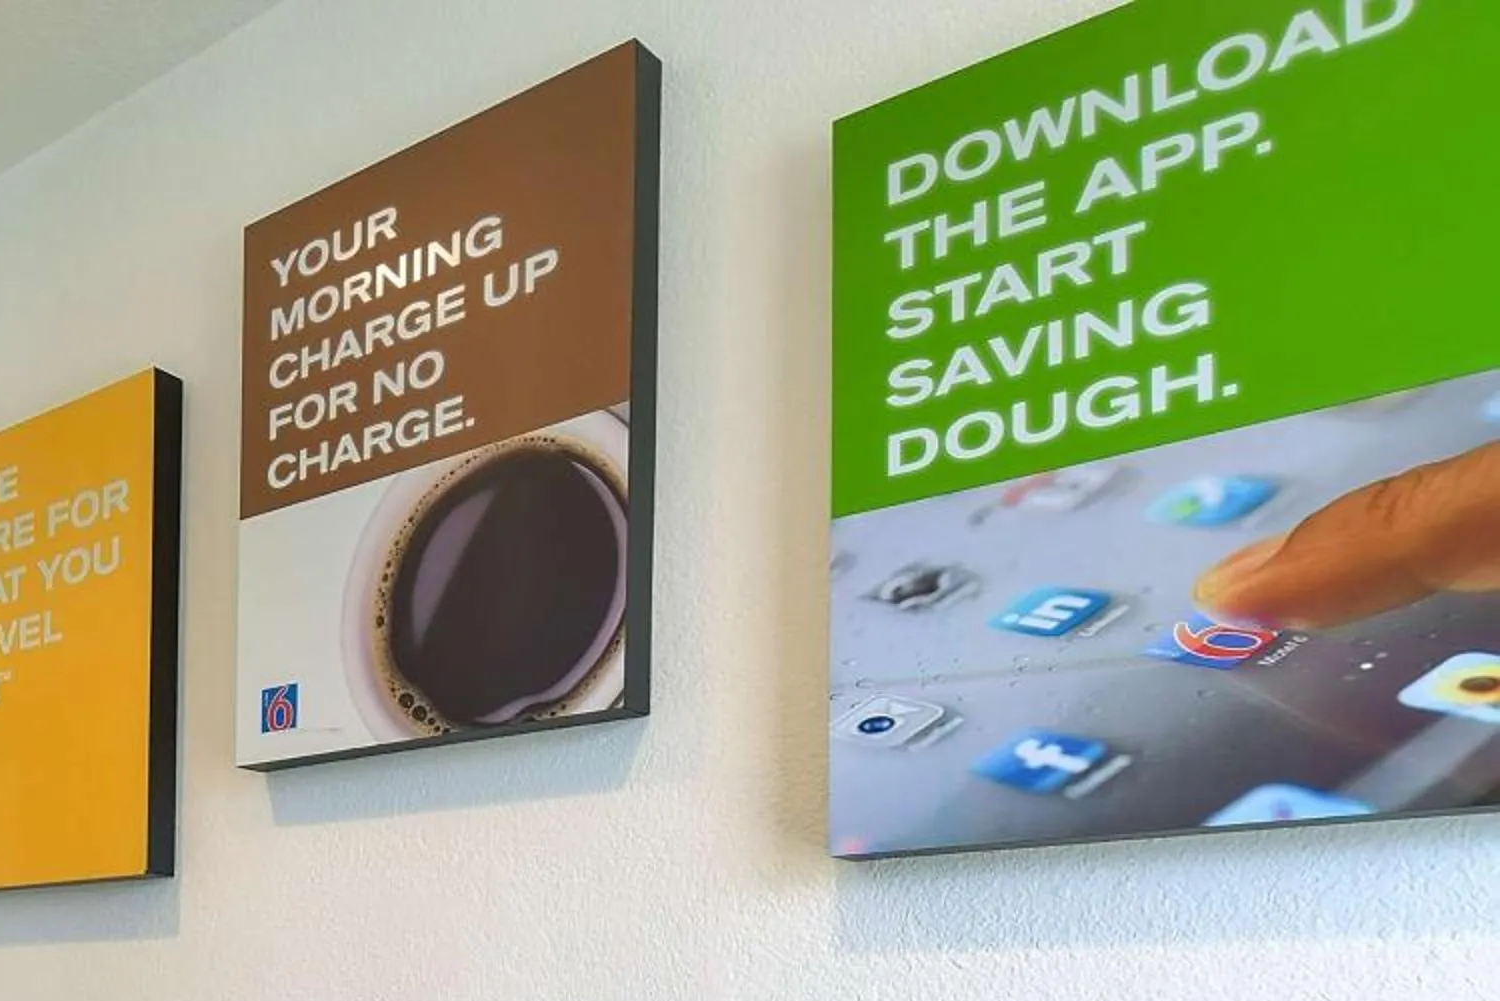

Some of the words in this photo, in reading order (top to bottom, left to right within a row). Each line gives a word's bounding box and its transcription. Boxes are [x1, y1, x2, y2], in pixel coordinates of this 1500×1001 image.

[887, 0, 1413, 205] DOWNLOAD
[884, 181, 1047, 269] THE
[1075, 111, 1272, 214] APP.
[270, 207, 398, 287] YOUR
[270, 216, 502, 341] MORNING
[886, 221, 1146, 339] START
[269, 284, 466, 389] CHARGE
[483, 249, 559, 308] UP
[886, 283, 1210, 407] SAVING
[267, 395, 475, 489] CHARGE.
[269, 381, 357, 441] FOR
[373, 350, 444, 405] NO
[887, 353, 1238, 476] DOUGH.
[48, 479, 130, 537] FOR
[37, 537, 120, 591] YOU
[1002, 594, 1092, 630] in
[267, 686, 294, 732] 6
